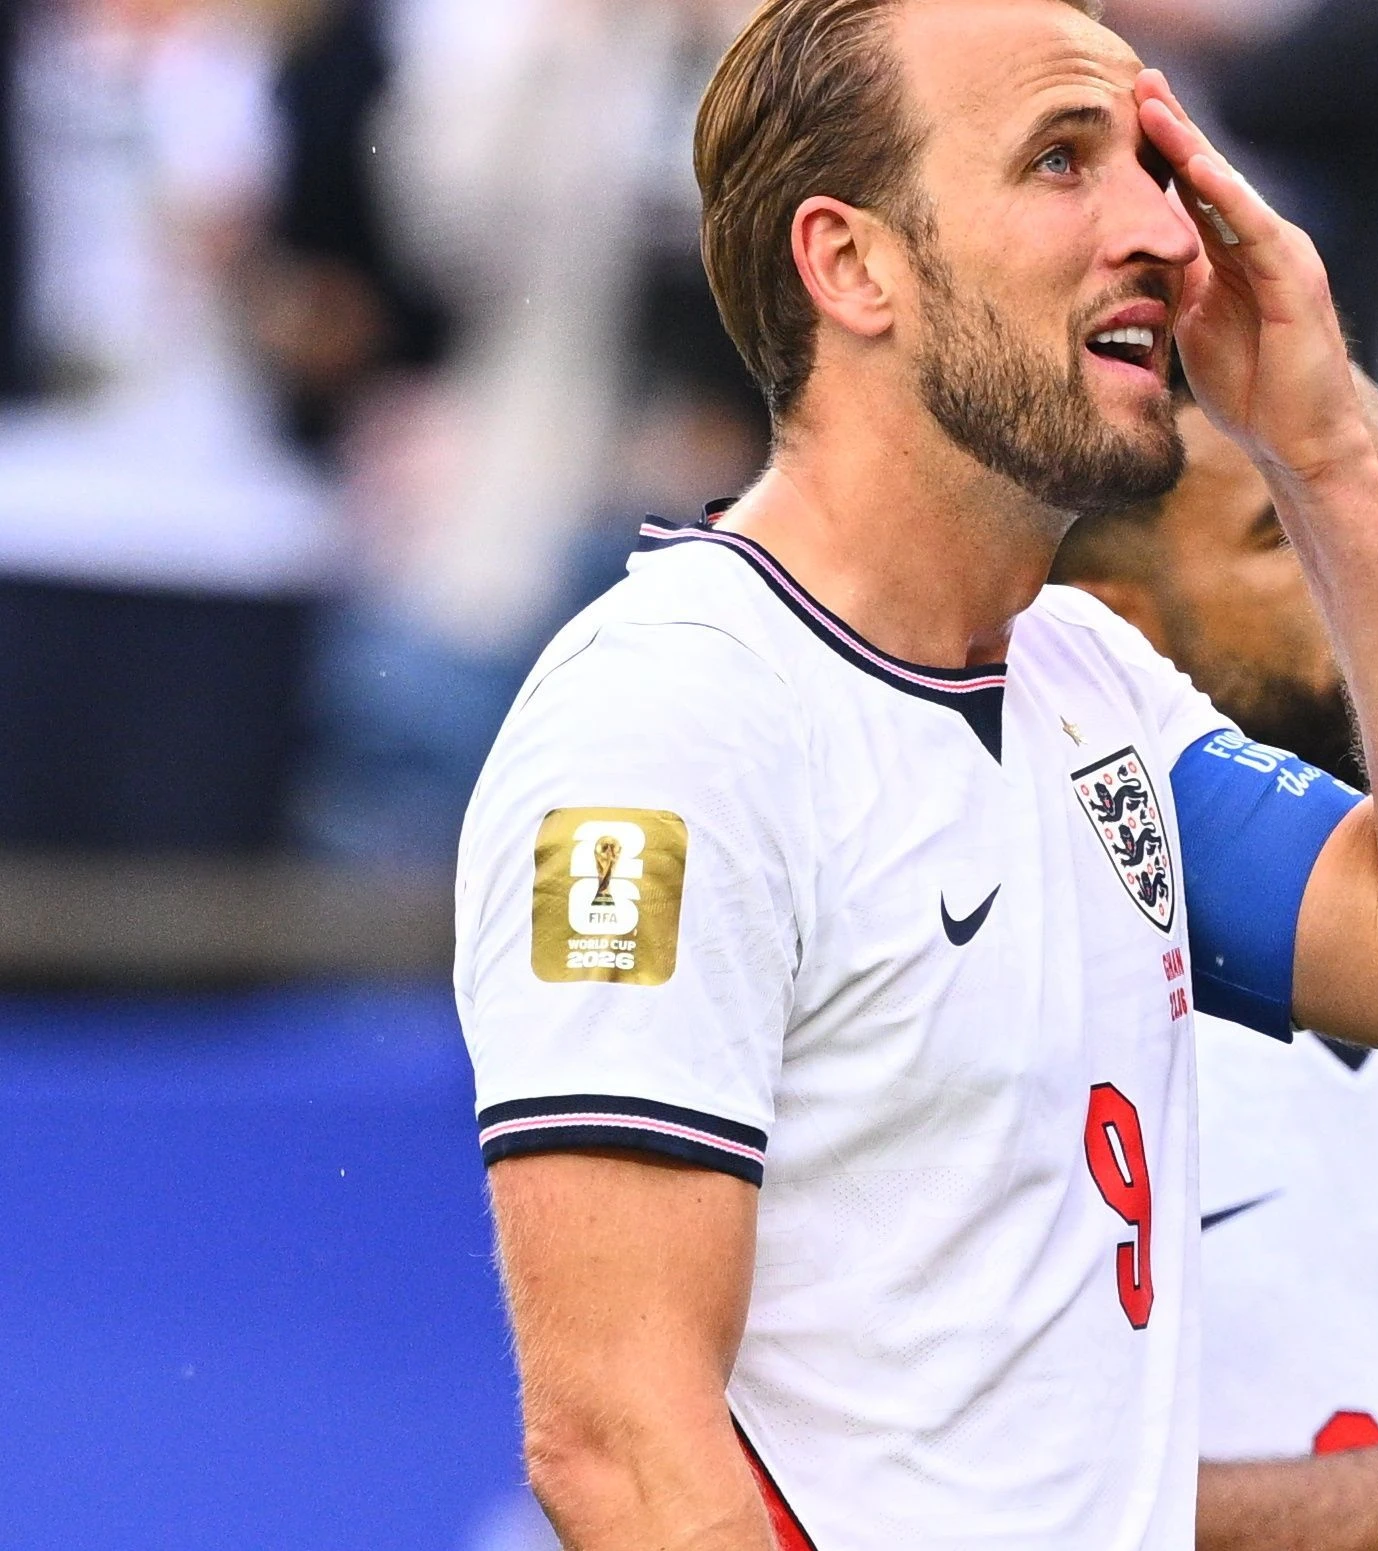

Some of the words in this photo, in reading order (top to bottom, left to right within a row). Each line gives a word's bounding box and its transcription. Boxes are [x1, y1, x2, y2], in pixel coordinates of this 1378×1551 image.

[1276, 767, 1321, 797] the
[589, 912, 617, 924] FIFA
[568, 939, 609, 950] WORLD
[610, 940, 637, 951] CUP
[566, 951, 635, 970] 2026
[1084, 1082, 1154, 1330] 9
